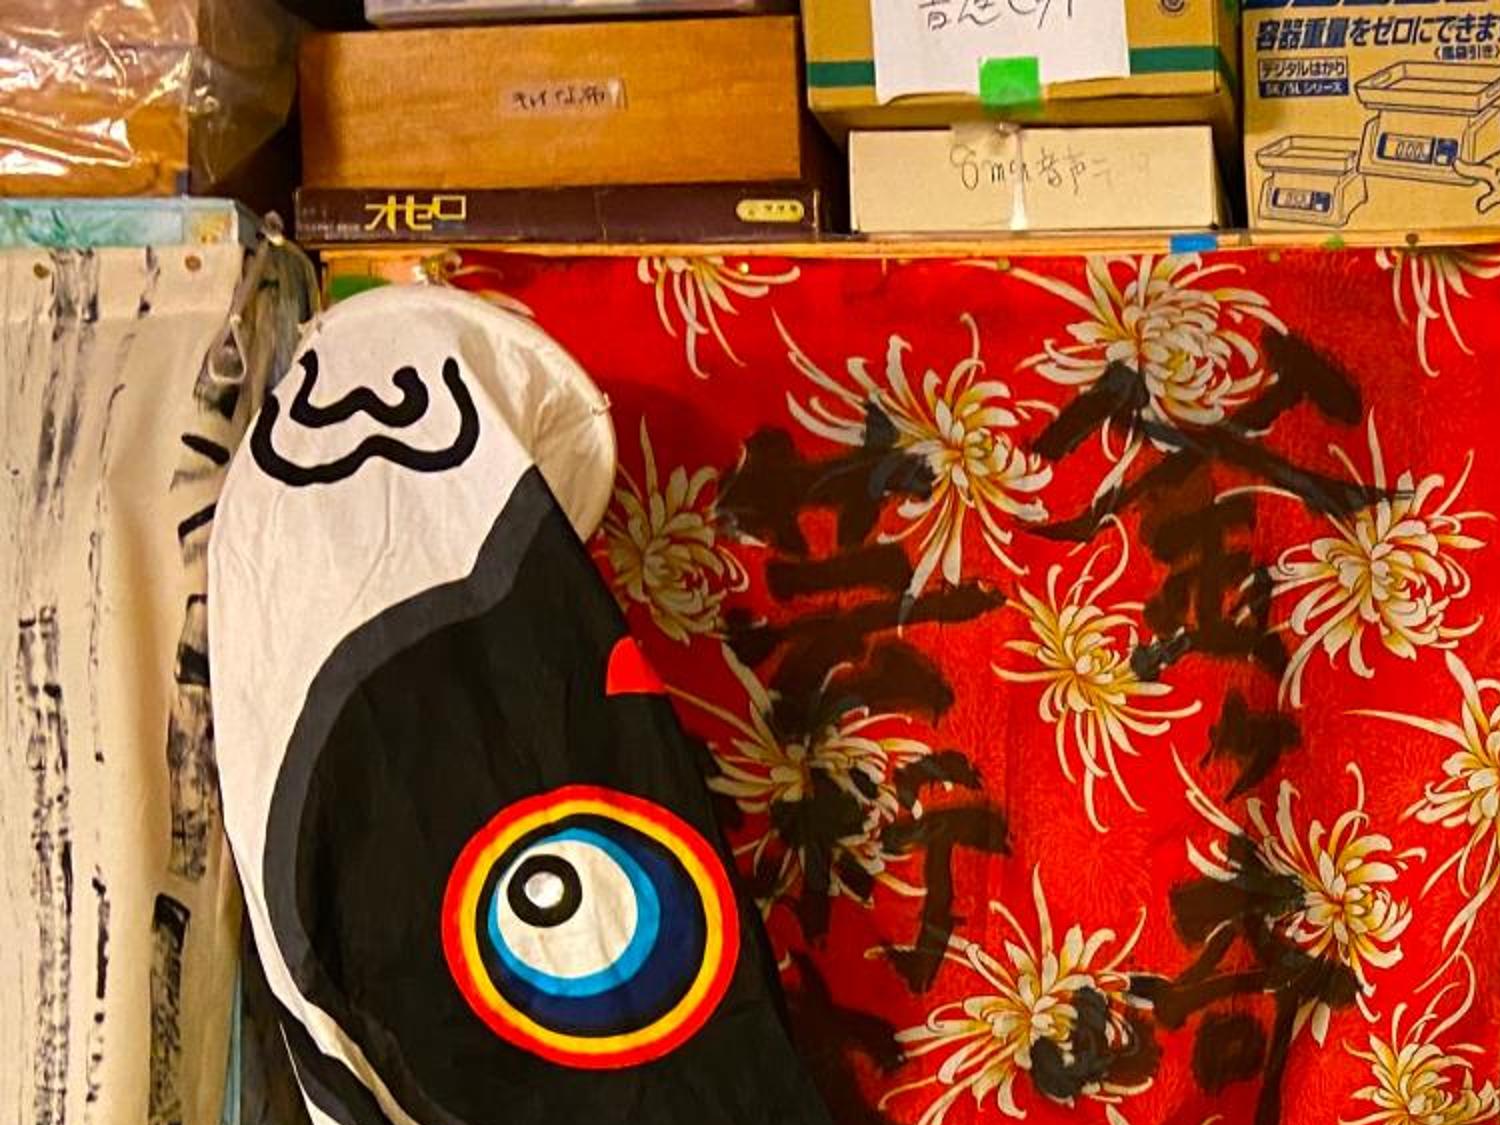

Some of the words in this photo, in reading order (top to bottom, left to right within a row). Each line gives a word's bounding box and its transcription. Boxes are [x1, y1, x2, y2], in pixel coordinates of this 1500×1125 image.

[1262, 61, 1345, 78] デジタルはかり
[364, 195, 468, 234] オセロ
